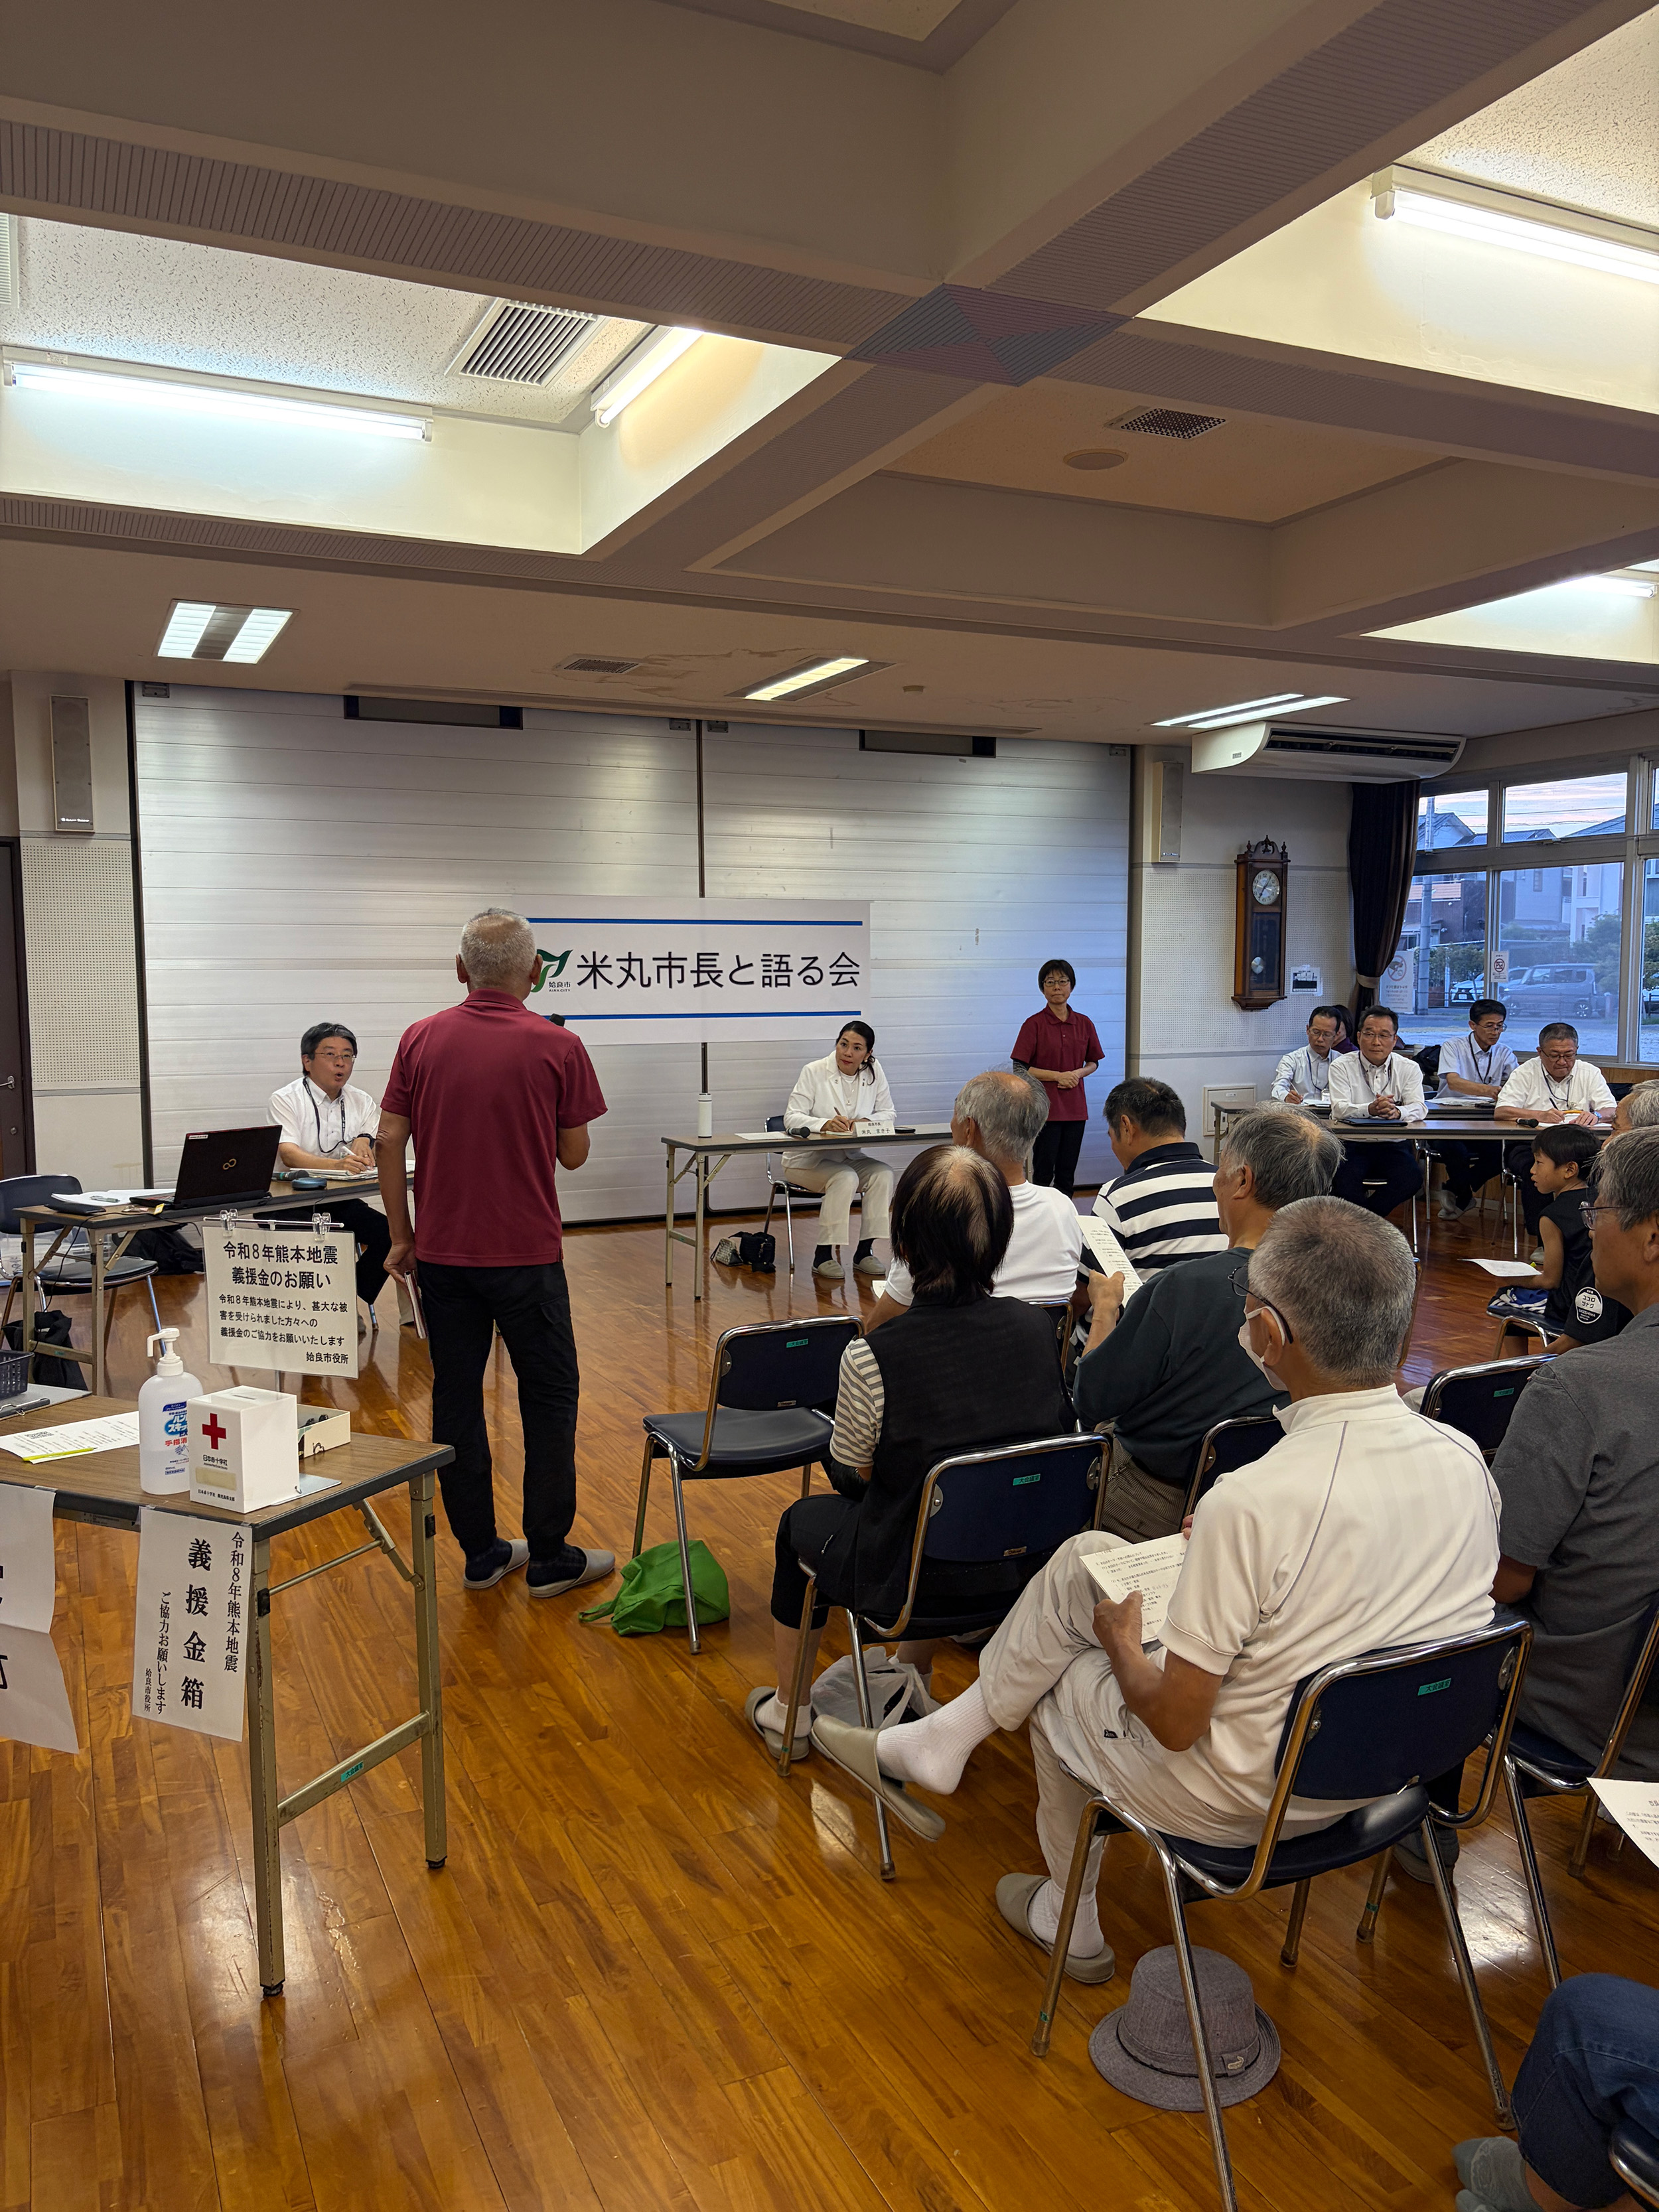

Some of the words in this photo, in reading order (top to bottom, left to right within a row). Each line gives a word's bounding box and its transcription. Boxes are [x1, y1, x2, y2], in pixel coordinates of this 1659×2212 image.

[577, 951, 860, 989] 米丸市長と語る会
[223, 1241, 338, 1265] 令和8年熊本地震
[232, 1267, 331, 1289] 義援金のお願い
[220, 1310, 318, 1328] 害を受けられました方々への
[220, 1326, 344, 1346] 義援金のご協力をお願いいたします
[306, 1351, 348, 1364] 姶良市役所
[224, 1531, 244, 1673] 令和8年熊本地震
[181, 1538, 212, 1710] 義援金箱
[155, 1592, 171, 1714] ご協力お願いします
